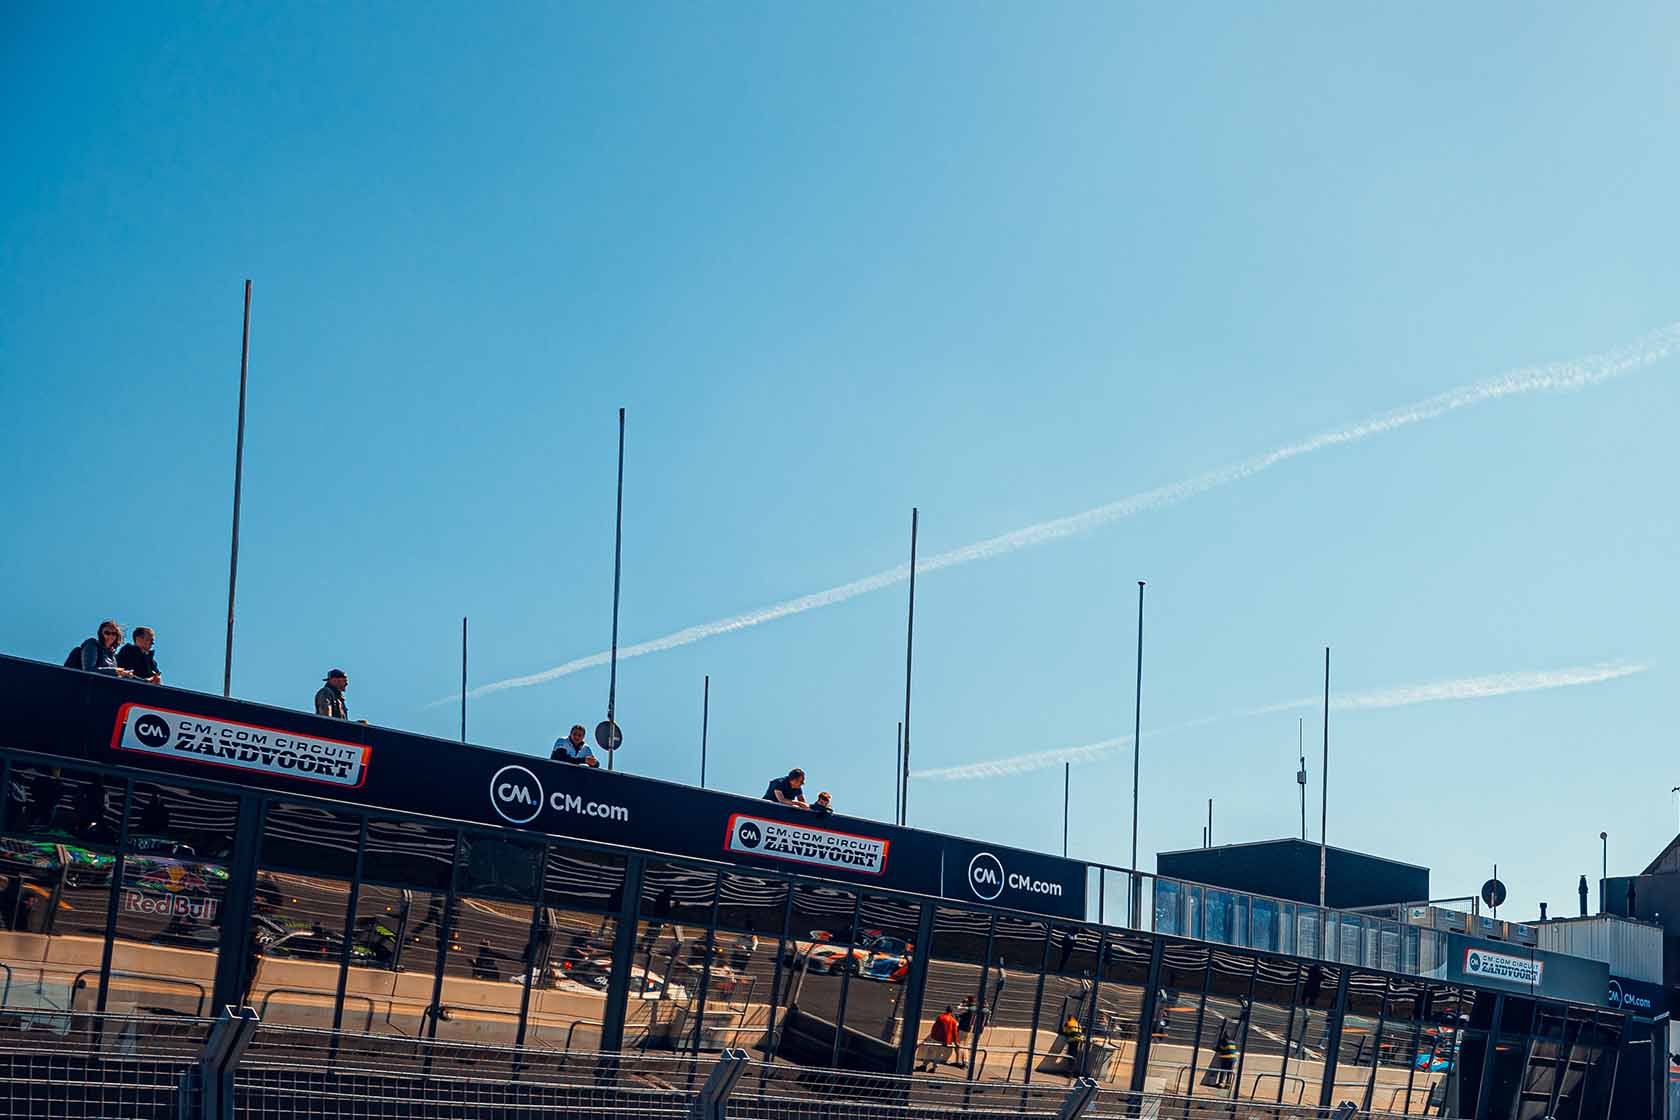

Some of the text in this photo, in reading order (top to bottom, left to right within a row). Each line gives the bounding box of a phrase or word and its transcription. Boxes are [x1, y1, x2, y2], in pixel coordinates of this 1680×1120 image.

[179, 721, 356, 760] CM.COM CIRCUIT
[174, 732, 353, 778] ZANDVOORT
[550, 792, 629, 821] CM.com
[763, 835, 878, 868] ZANDVOORT
[766, 826, 880, 853] CM.COM CIRCUIT
[1008, 873, 1062, 896] CM.com
[124, 890, 172, 915] Red
[1481, 961, 1538, 982] ZANDVOORT
